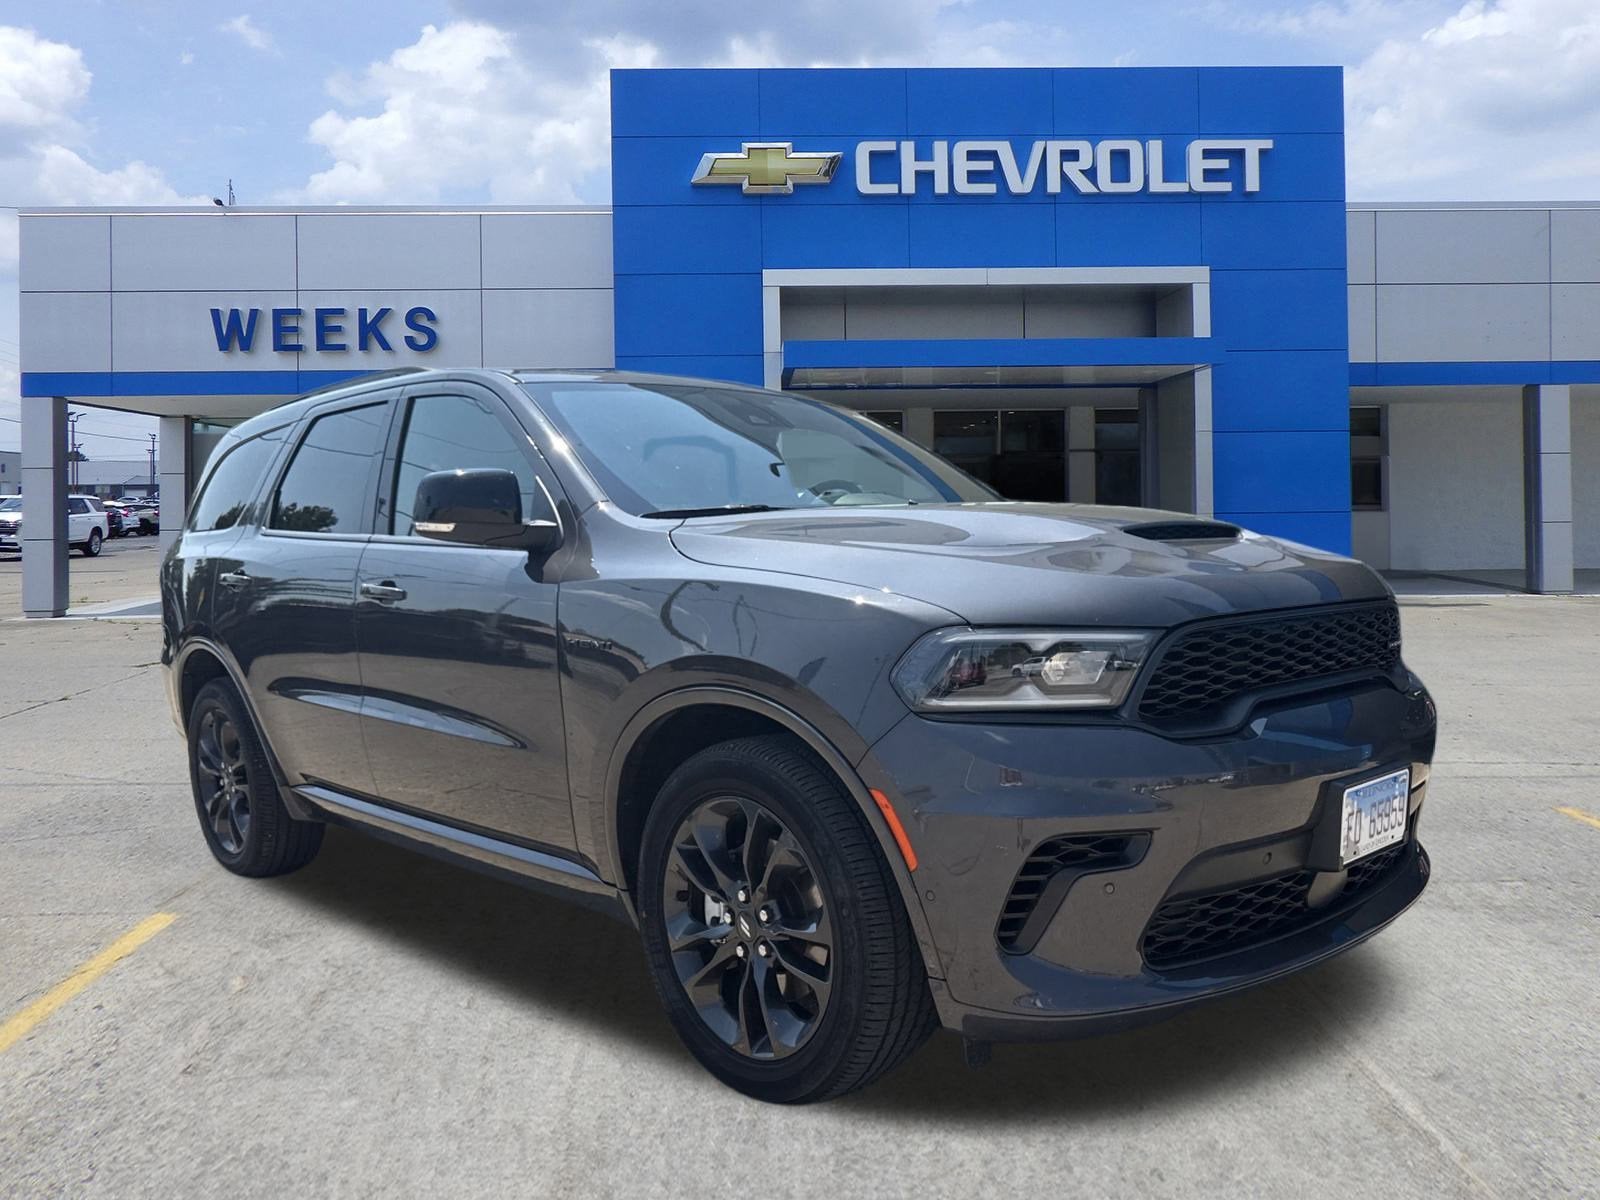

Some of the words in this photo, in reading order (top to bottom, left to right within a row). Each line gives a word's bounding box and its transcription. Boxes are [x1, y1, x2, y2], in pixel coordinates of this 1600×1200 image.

[855, 138, 1274, 196] CHEVROLET
[210, 306, 438, 353] WEEKS
[1369, 792, 1404, 838] 65959
